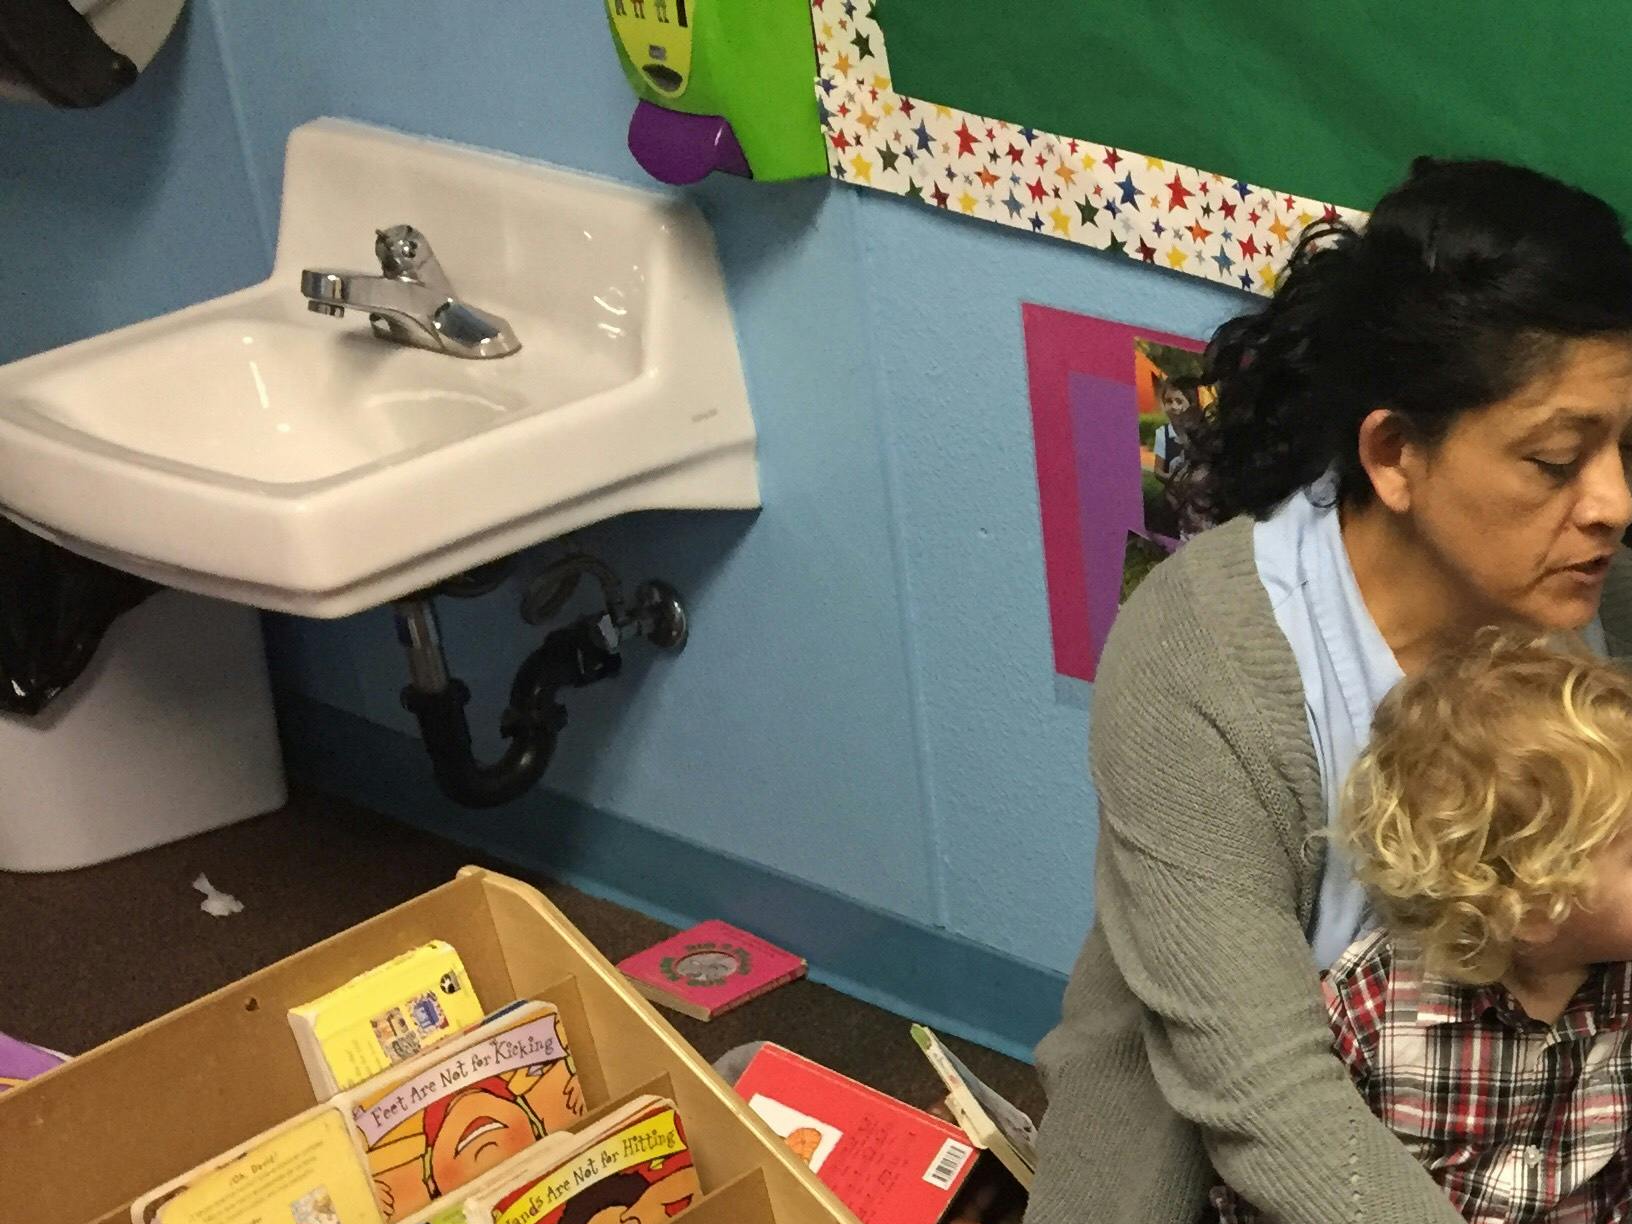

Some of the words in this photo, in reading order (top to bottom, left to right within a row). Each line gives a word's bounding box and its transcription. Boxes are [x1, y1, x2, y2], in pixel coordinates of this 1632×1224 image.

[370, 1095, 409, 1128] Feet
[410, 1080, 437, 1105] Are
[440, 1060, 469, 1090] Not
[471, 1052, 492, 1073] for
[490, 1036, 555, 1065] Kicking
[546, 1179, 570, 1204] Are
[572, 1158, 599, 1186] Not
[600, 1150, 620, 1169] for
[622, 1129, 677, 1158] Hitting
